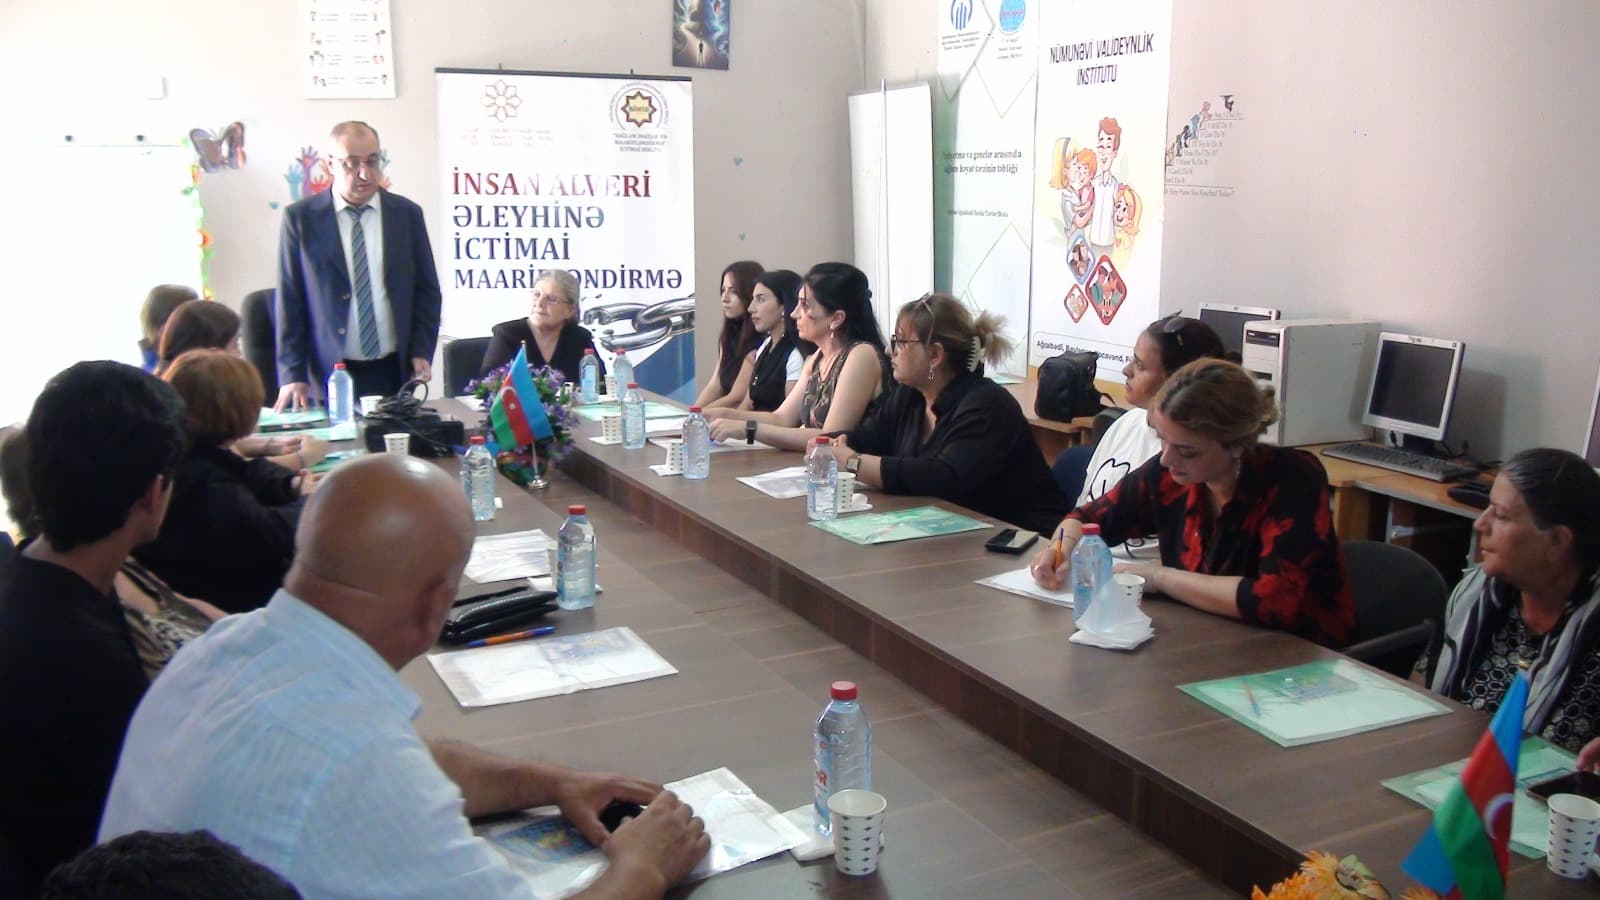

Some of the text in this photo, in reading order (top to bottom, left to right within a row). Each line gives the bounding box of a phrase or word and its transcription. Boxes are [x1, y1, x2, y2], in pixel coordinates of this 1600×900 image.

[1050, 38, 1093, 64] NÜMUNƏVİ
[1096, 31, 1154, 60] VALİDEYNLİK
[1076, 63, 1118, 86] İNSTİTUTU
[452, 167, 652, 198] İNSAN ALVERİ
[453, 200, 605, 229] ƏLEYHİNƏ
[453, 232, 571, 260] İCTİMAİ
